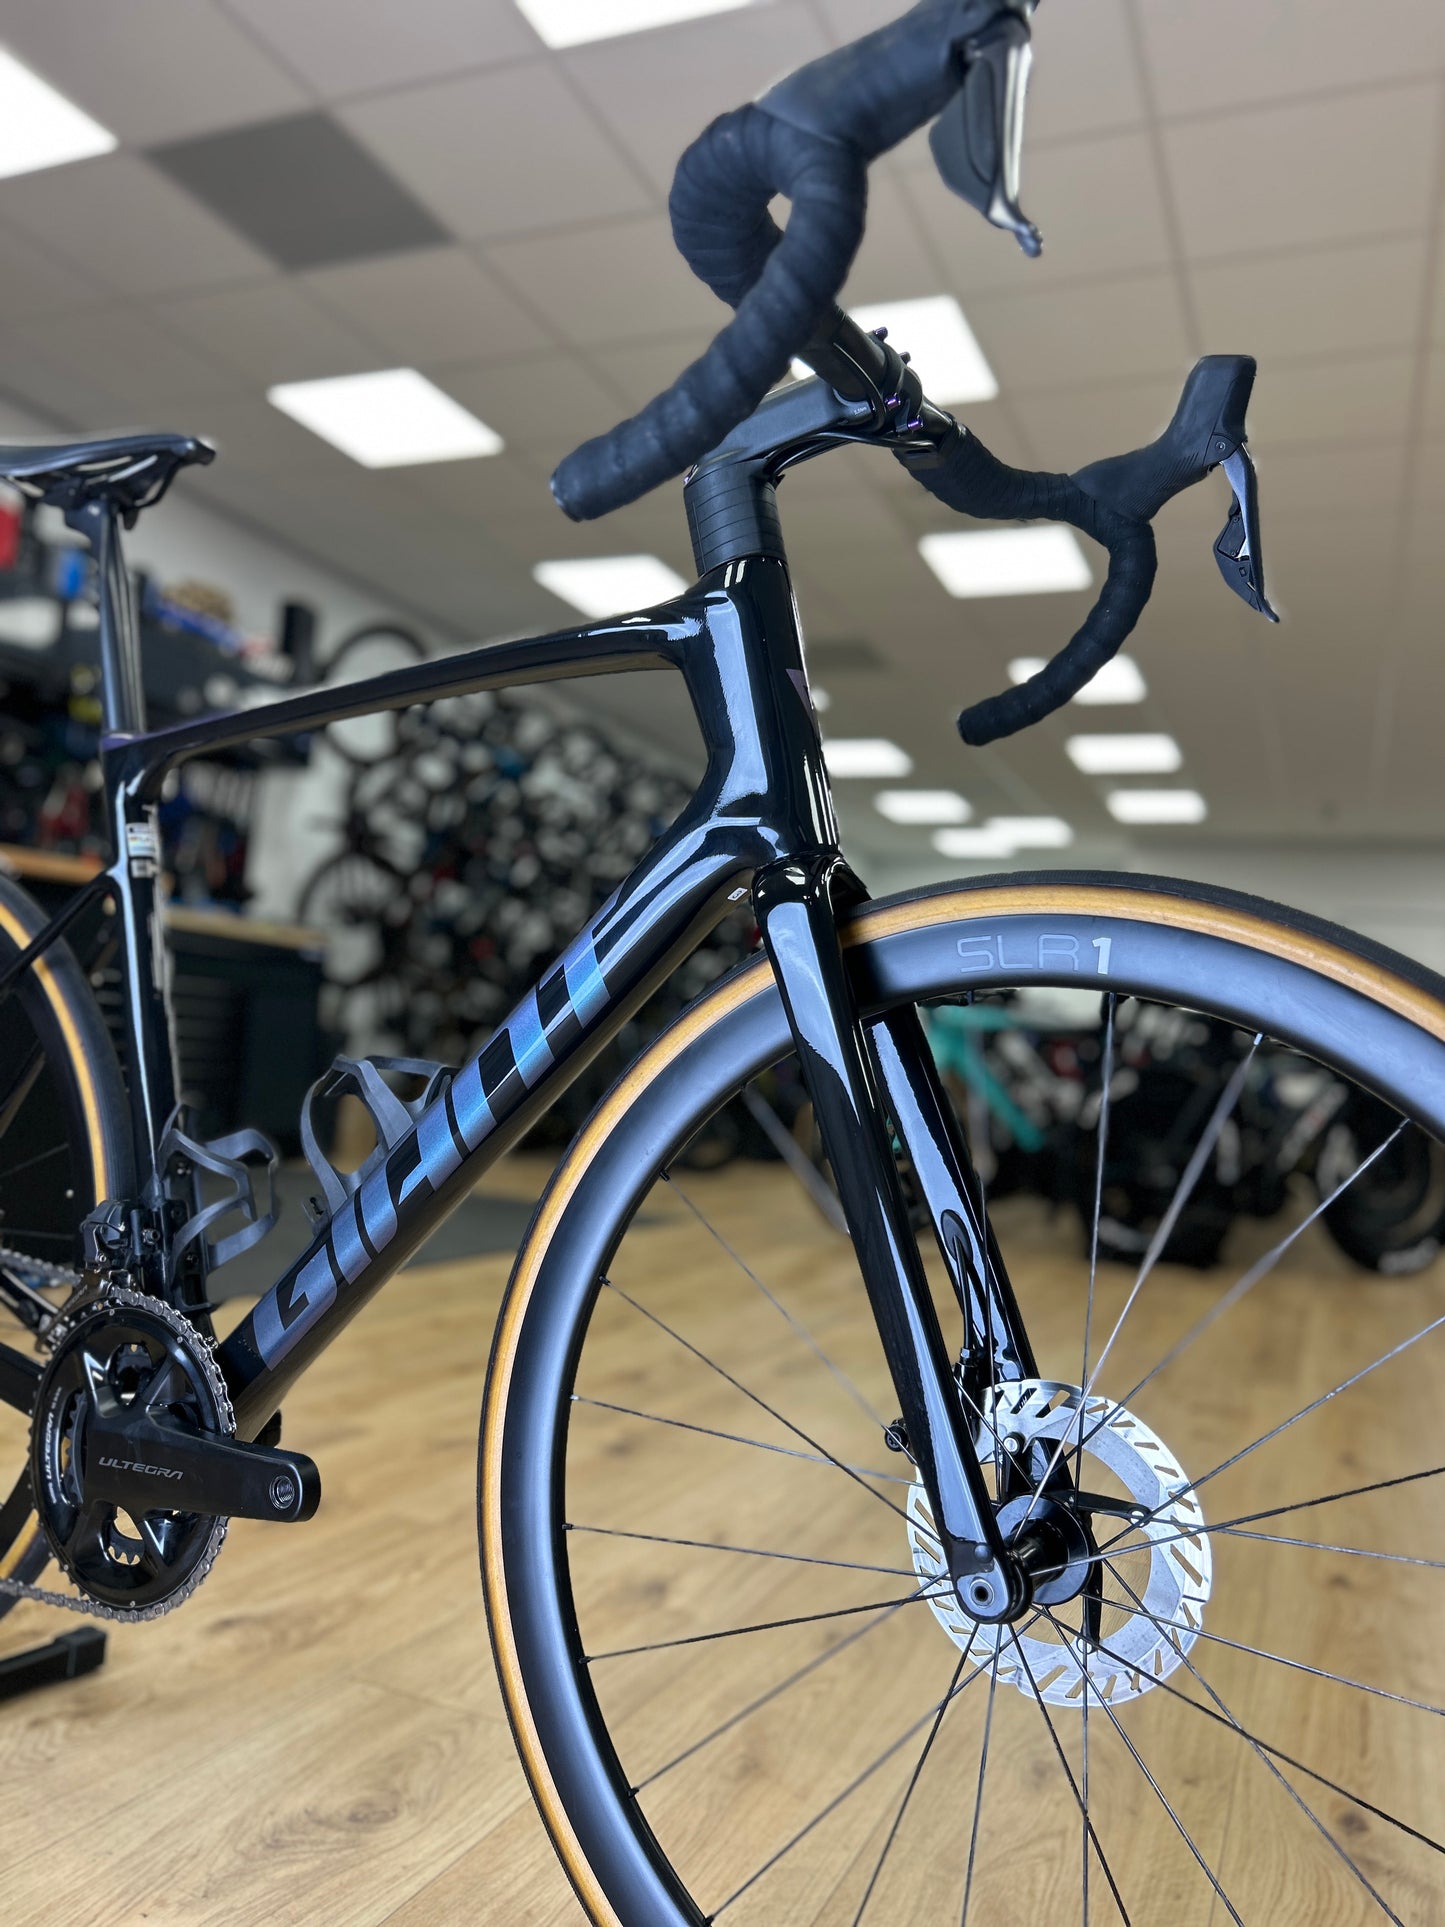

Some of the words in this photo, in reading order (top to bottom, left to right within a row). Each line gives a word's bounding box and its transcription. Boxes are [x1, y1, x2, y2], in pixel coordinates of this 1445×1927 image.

[957, 934, 1079, 973] SLR
[252, 870, 630, 1371] GIANT
[99, 1457, 183, 1480] ULTEGRA
